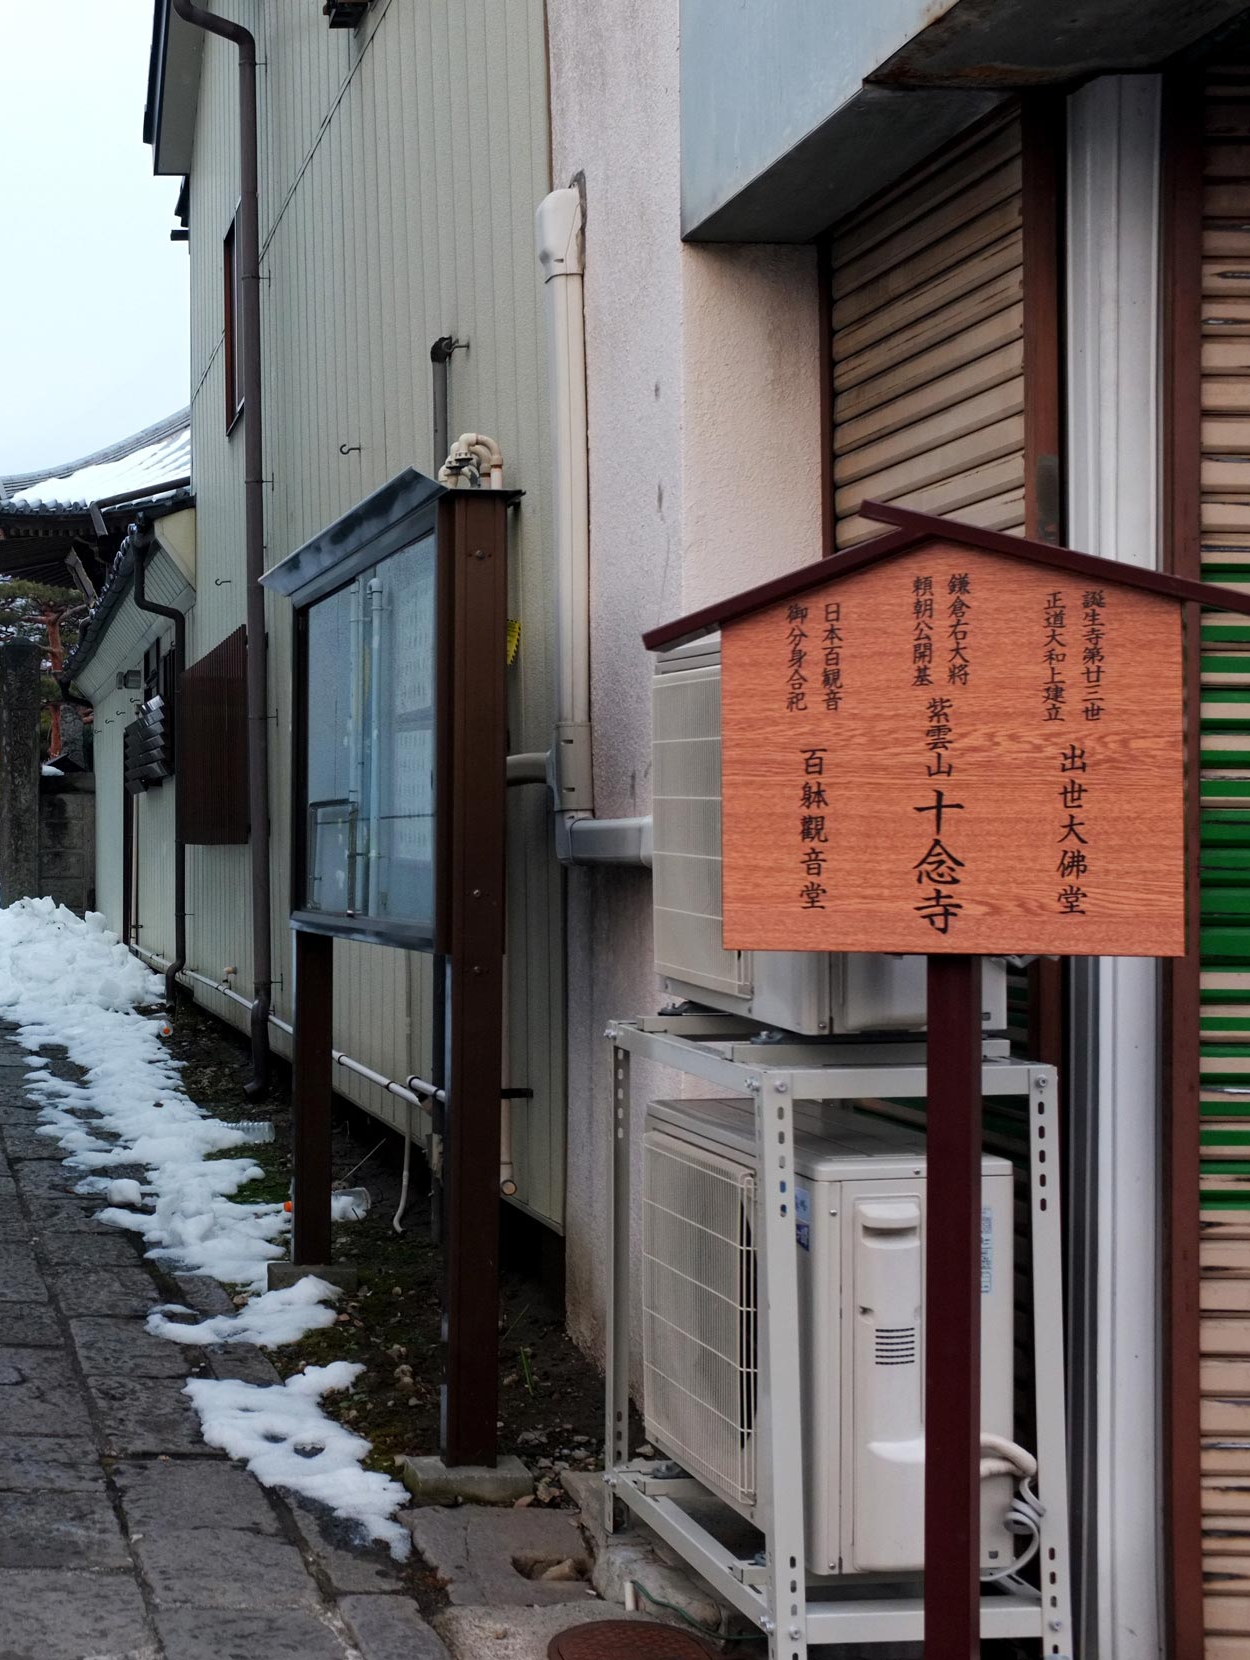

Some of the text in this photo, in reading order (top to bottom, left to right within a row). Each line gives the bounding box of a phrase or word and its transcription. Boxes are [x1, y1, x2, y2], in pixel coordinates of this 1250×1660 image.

[786, 604, 809, 712] 御分身合祀
[912, 575, 935, 687] 頼朝公開基
[1042, 591, 1067, 722] 正道大和上建立
[1056, 743, 1088, 915] 出世大佛堂
